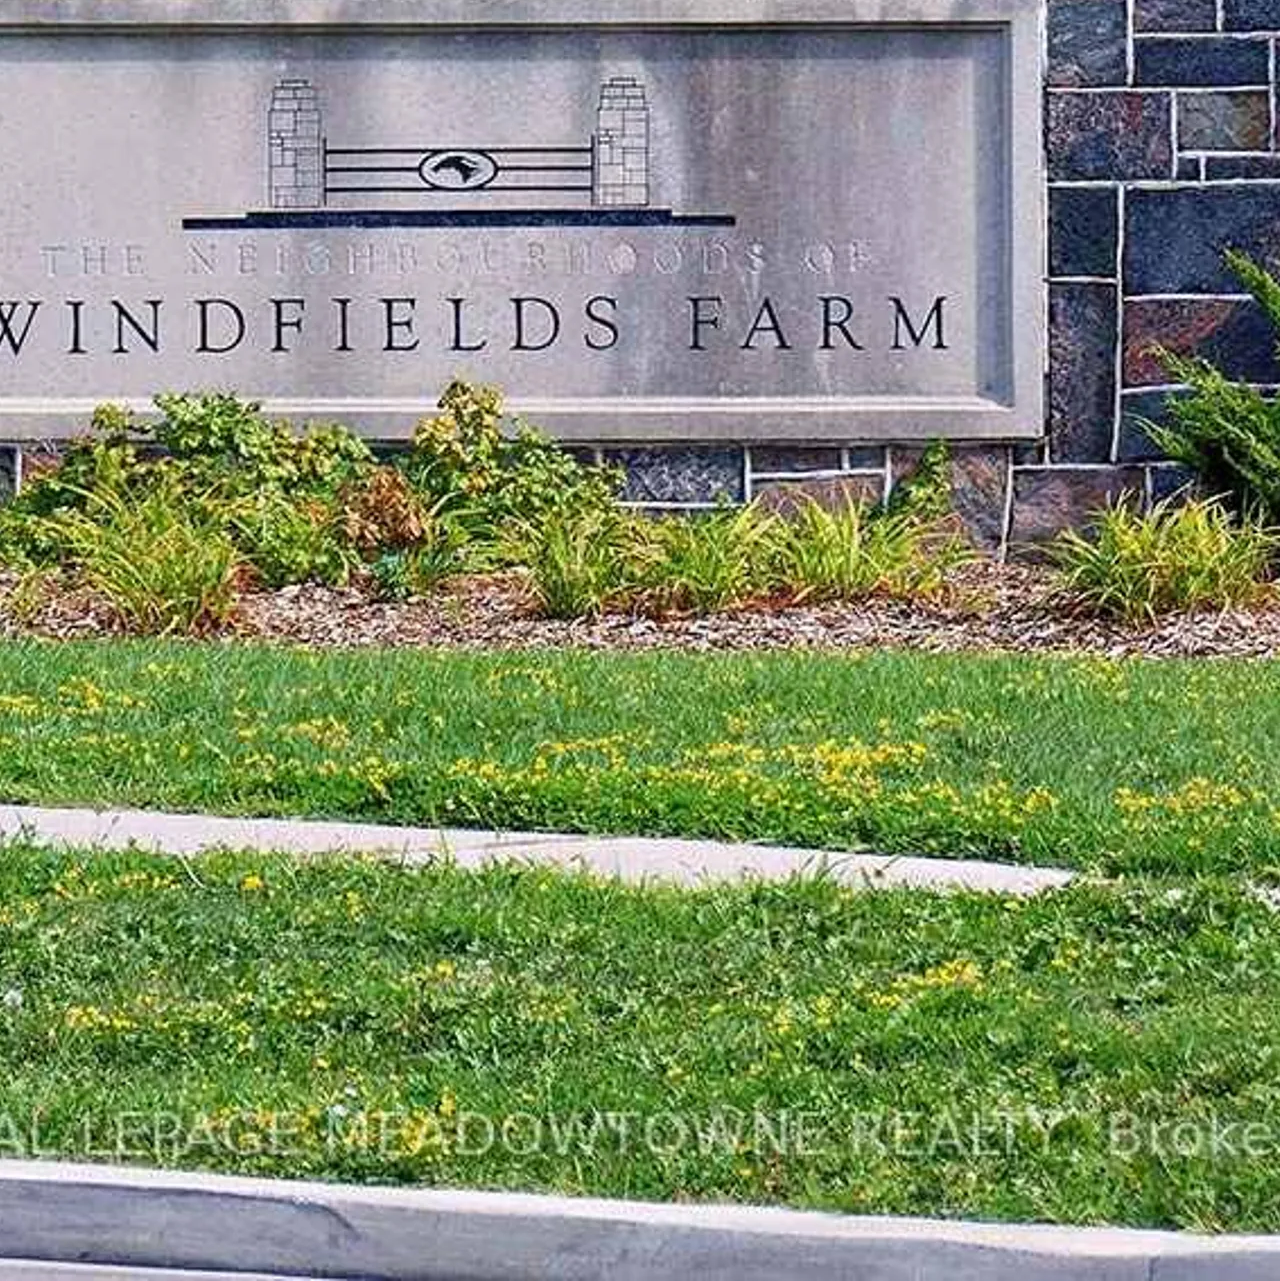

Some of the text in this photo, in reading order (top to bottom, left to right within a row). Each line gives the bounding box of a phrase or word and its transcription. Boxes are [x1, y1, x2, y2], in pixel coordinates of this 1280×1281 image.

[41, 238, 873, 276] THE NEIGHBOURHOODS OF
[688, 295, 948, 351] FARM
